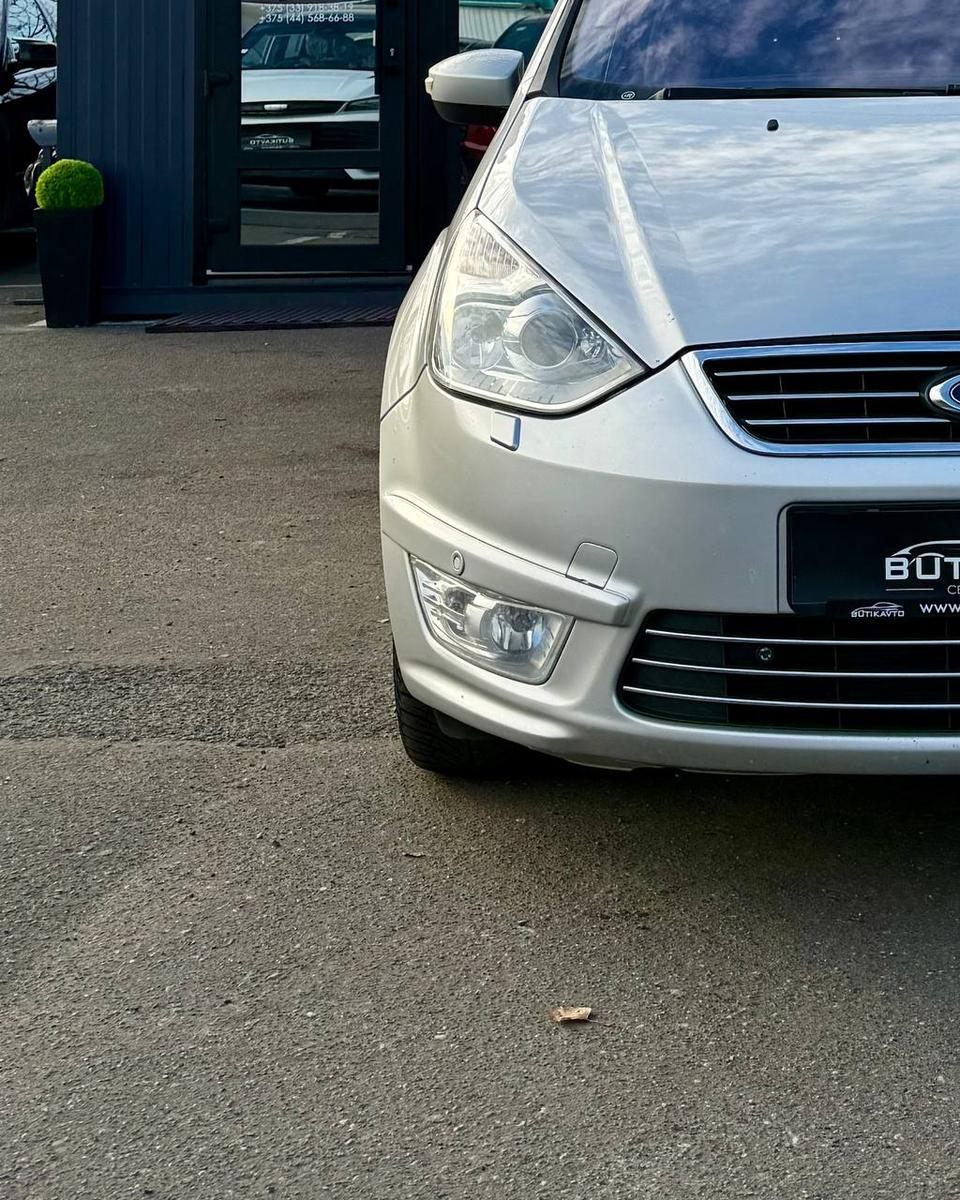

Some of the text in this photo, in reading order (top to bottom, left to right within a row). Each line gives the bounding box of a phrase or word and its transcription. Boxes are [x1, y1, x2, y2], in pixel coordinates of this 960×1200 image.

[260, 12, 355, 24] +375 (44) 568-66-88
[851, 609, 905, 618] BUTIKAVTO
